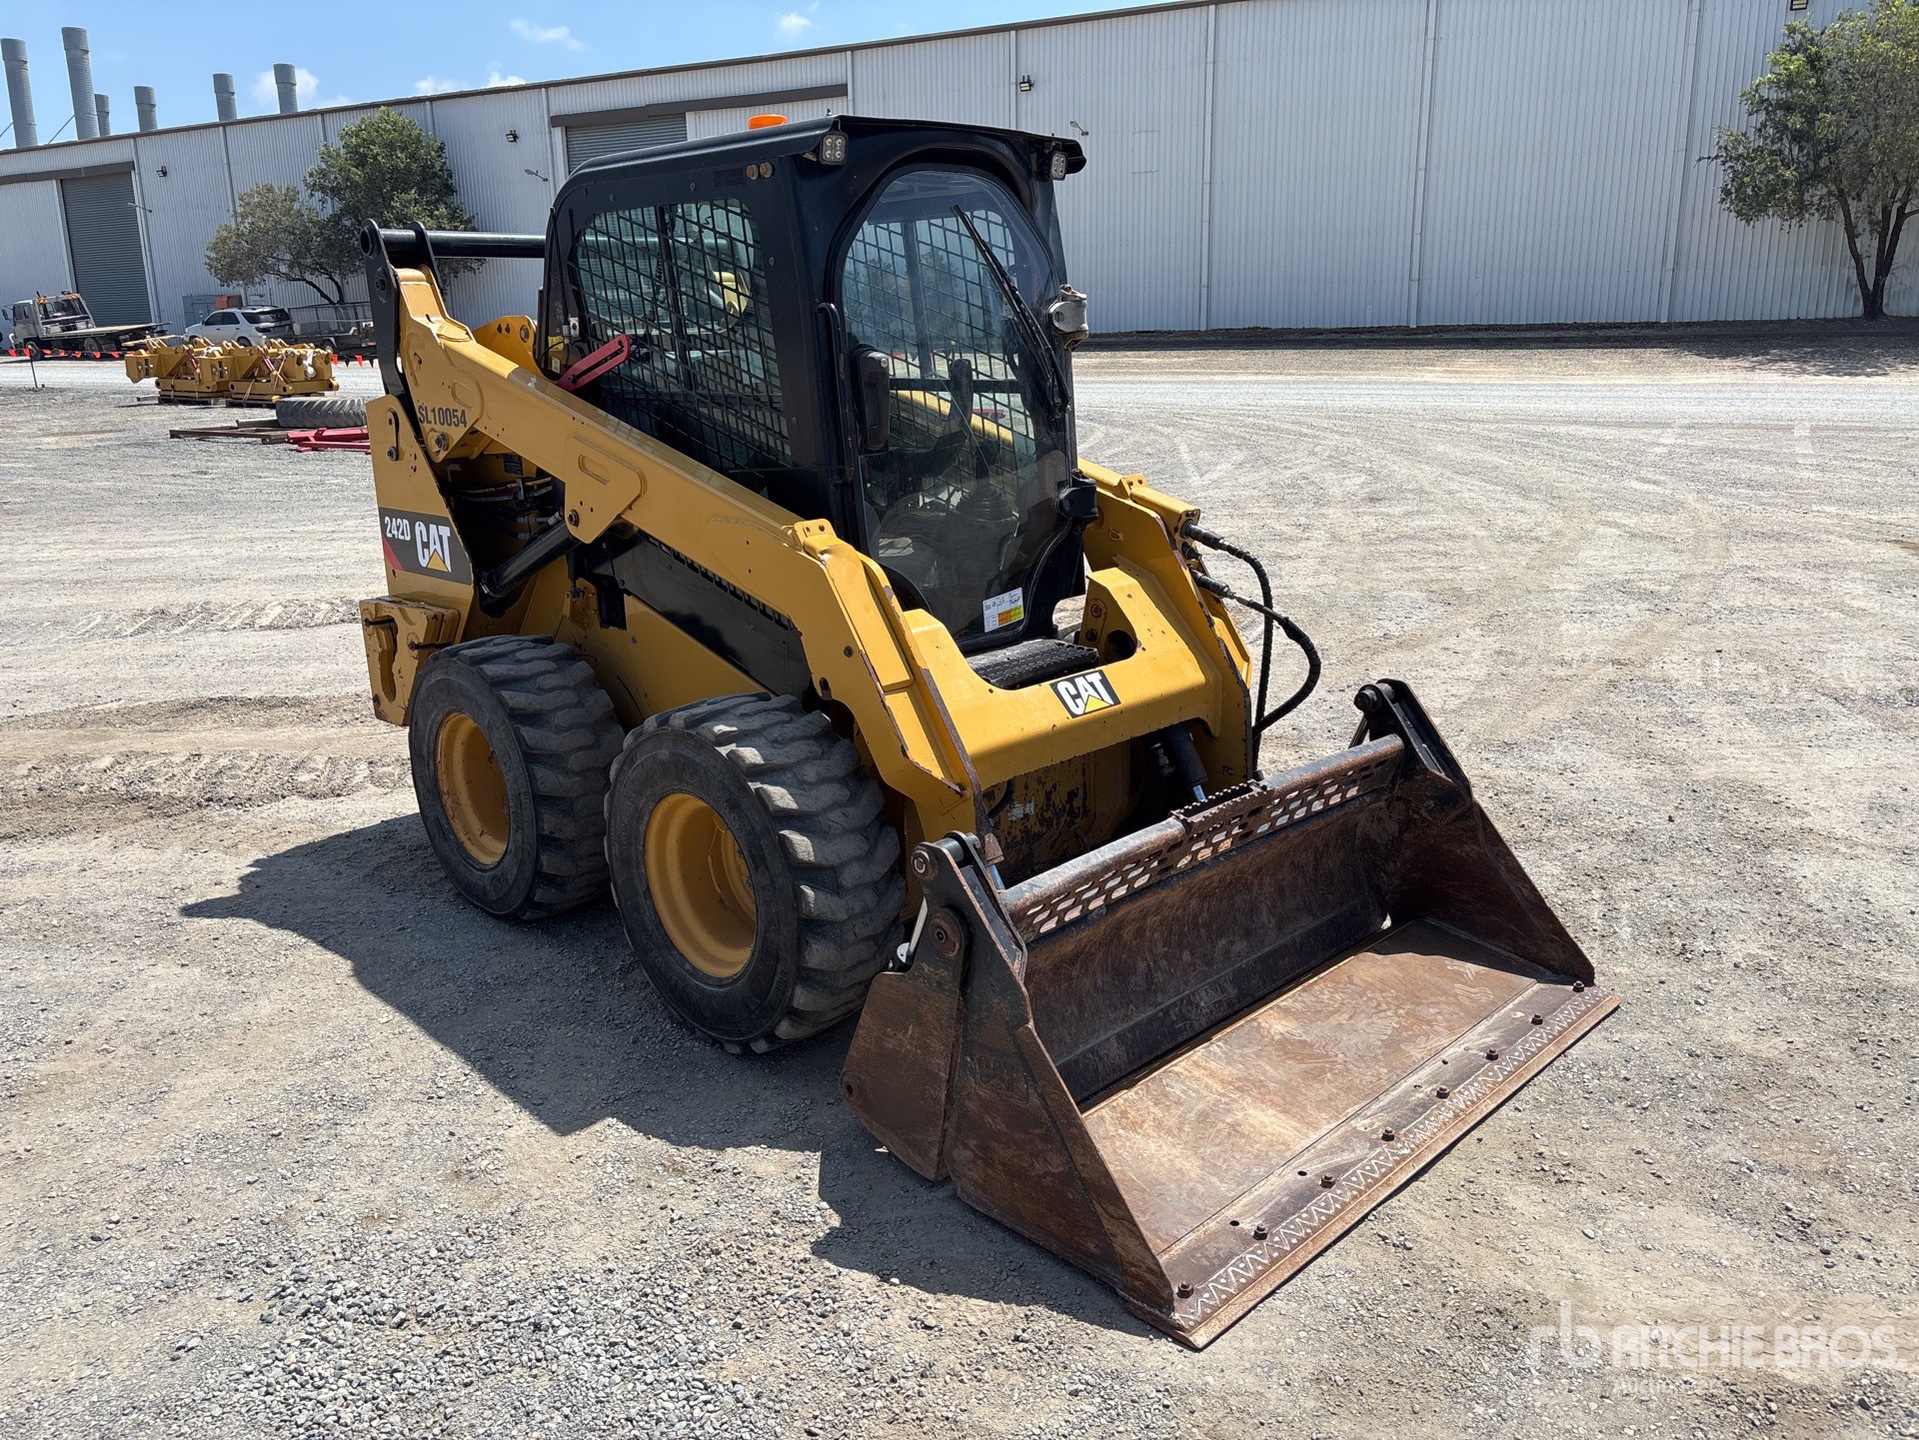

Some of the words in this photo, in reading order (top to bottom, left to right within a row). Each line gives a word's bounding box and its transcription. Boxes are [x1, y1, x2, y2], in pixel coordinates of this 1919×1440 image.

[418, 405, 468, 428] SL10054
[384, 516, 411, 541] 242D
[415, 520, 452, 573] CAT
[1056, 671, 1115, 716] CAT
